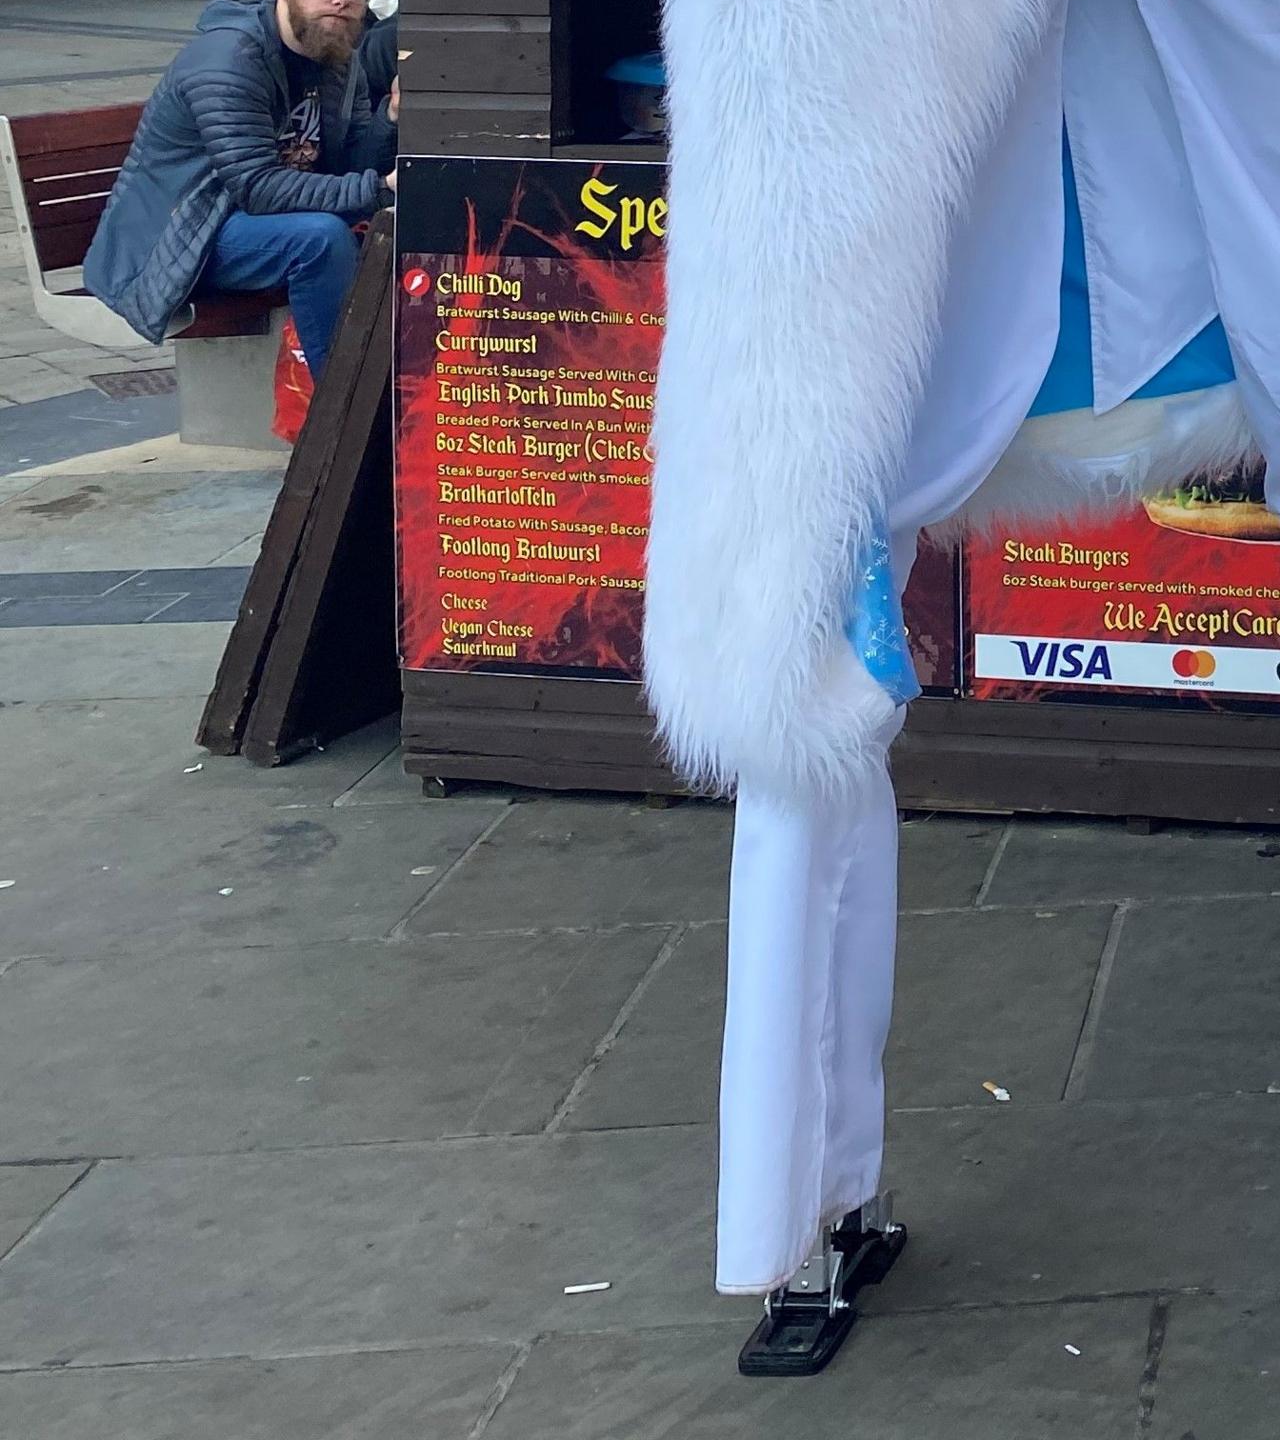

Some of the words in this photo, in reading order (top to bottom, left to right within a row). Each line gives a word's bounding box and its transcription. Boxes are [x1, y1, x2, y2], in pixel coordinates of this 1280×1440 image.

[436, 272, 484, 296] Chilli
[486, 272, 522, 301] Dog
[436, 305, 500, 319] Bratwurst
[502, 307, 556, 323] Sausage
[558, 310, 589, 323] With
[590, 311, 623, 324] Chilli
[625, 313, 634, 325] &
[435, 330, 537, 357] Currywurst
[436, 362, 500, 376] Bratwurst
[502, 365, 555, 381] Sausage
[558, 367, 602, 381] Served
[605, 369, 636, 382] With
[437, 380, 501, 408] English
[504, 382, 549, 405] Pork
[552, 384, 607, 408] Jumbo
[436, 414, 489, 427] Breaded
[491, 415, 521, 428] Pork
[523, 417, 568, 431] Served
[571, 419, 583, 431] In
[585, 420, 595, 431] A
[597, 421, 622, 433] Bun
[436, 432, 464, 453] 6oz
[468, 433, 517, 454] Steak
[522, 434, 581, 462] Burger
[438, 464, 473, 477] Steak
[475, 466, 518, 480] Burger
[521, 468, 566, 482] Served
[569, 470, 597, 483] with
[599, 472, 650, 485] smoked
[438, 481, 556, 507] Bratkartoffeln
[438, 514, 470, 526] Fried
[473, 516, 516, 529] Potato
[518, 518, 548, 530] With
[550, 519, 608, 535] Sausage,
[610, 523, 650, 536] Bacon
[439, 534, 510, 563] Footlong
[515, 537, 601, 562] Bratwurst
[1002, 539, 1055, 564] Steak
[1058, 542, 1130, 571] Burgers
[438, 566, 496, 583] Footlong
[499, 569, 566, 584] Traditional
[569, 573, 598, 586] Pork
[1003, 574, 1027, 587] 6oz
[1029, 575, 1067, 589] Steak
[1070, 577, 1115, 592] burger
[1118, 580, 1164, 594] served
[1167, 582, 1196, 595] with
[1199, 584, 1253, 598] smoked
[441, 593, 487, 611] Cheese
[441, 617, 483, 637] Vegan
[487, 619, 533, 638] Cheese
[1103, 601, 1145, 632] We
[1149, 602, 1229, 639] Accept
[442, 637, 516, 657] Sauerkraut
[1010, 640, 1113, 680] VISA
